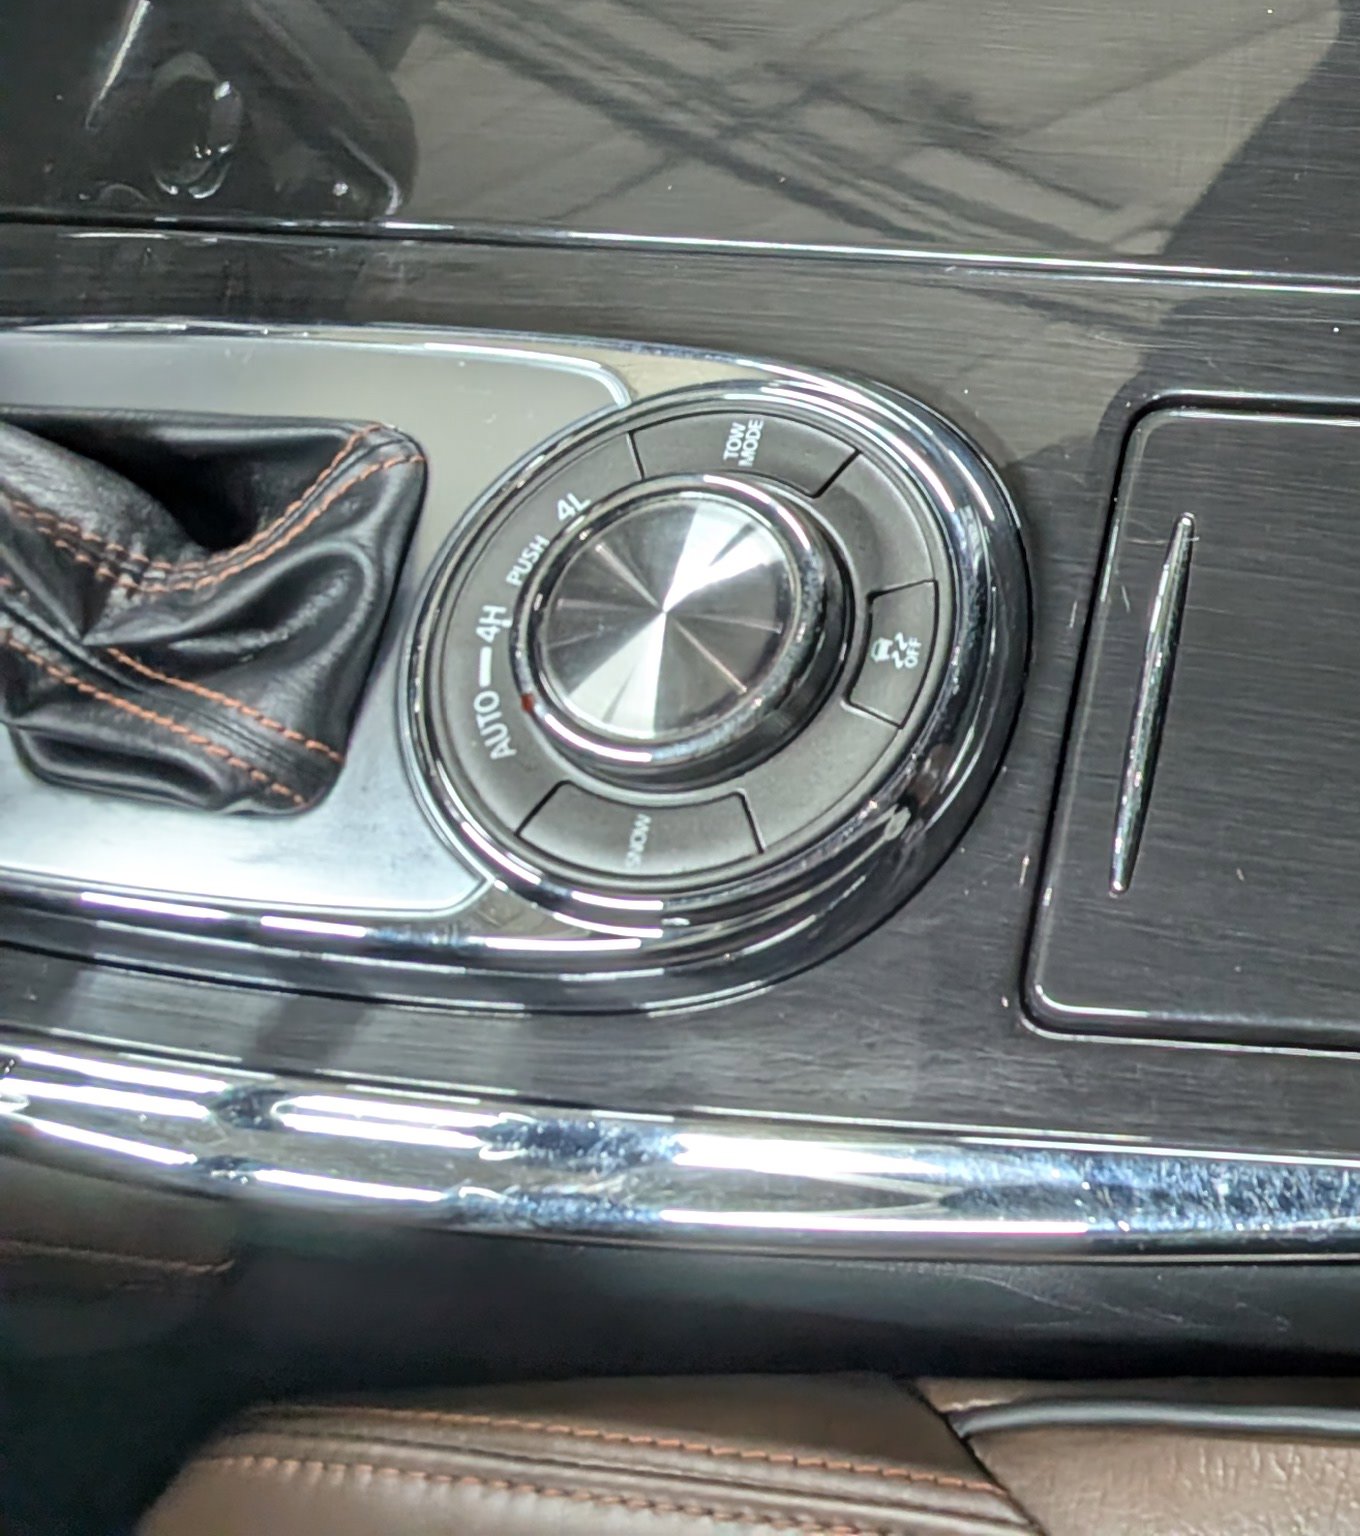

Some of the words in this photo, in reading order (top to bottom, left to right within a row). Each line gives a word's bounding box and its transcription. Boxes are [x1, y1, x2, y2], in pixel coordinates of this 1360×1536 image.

[722, 421, 747, 461] TOW
[738, 419, 765, 467] MODE
[556, 492, 592, 522] 4L
[505, 533, 551, 587] PUSH
[475, 605, 513, 644] 4H
[904, 636, 922, 669] OFF
[473, 689, 518, 761] AUTO
[625, 813, 652, 867] SNOW
